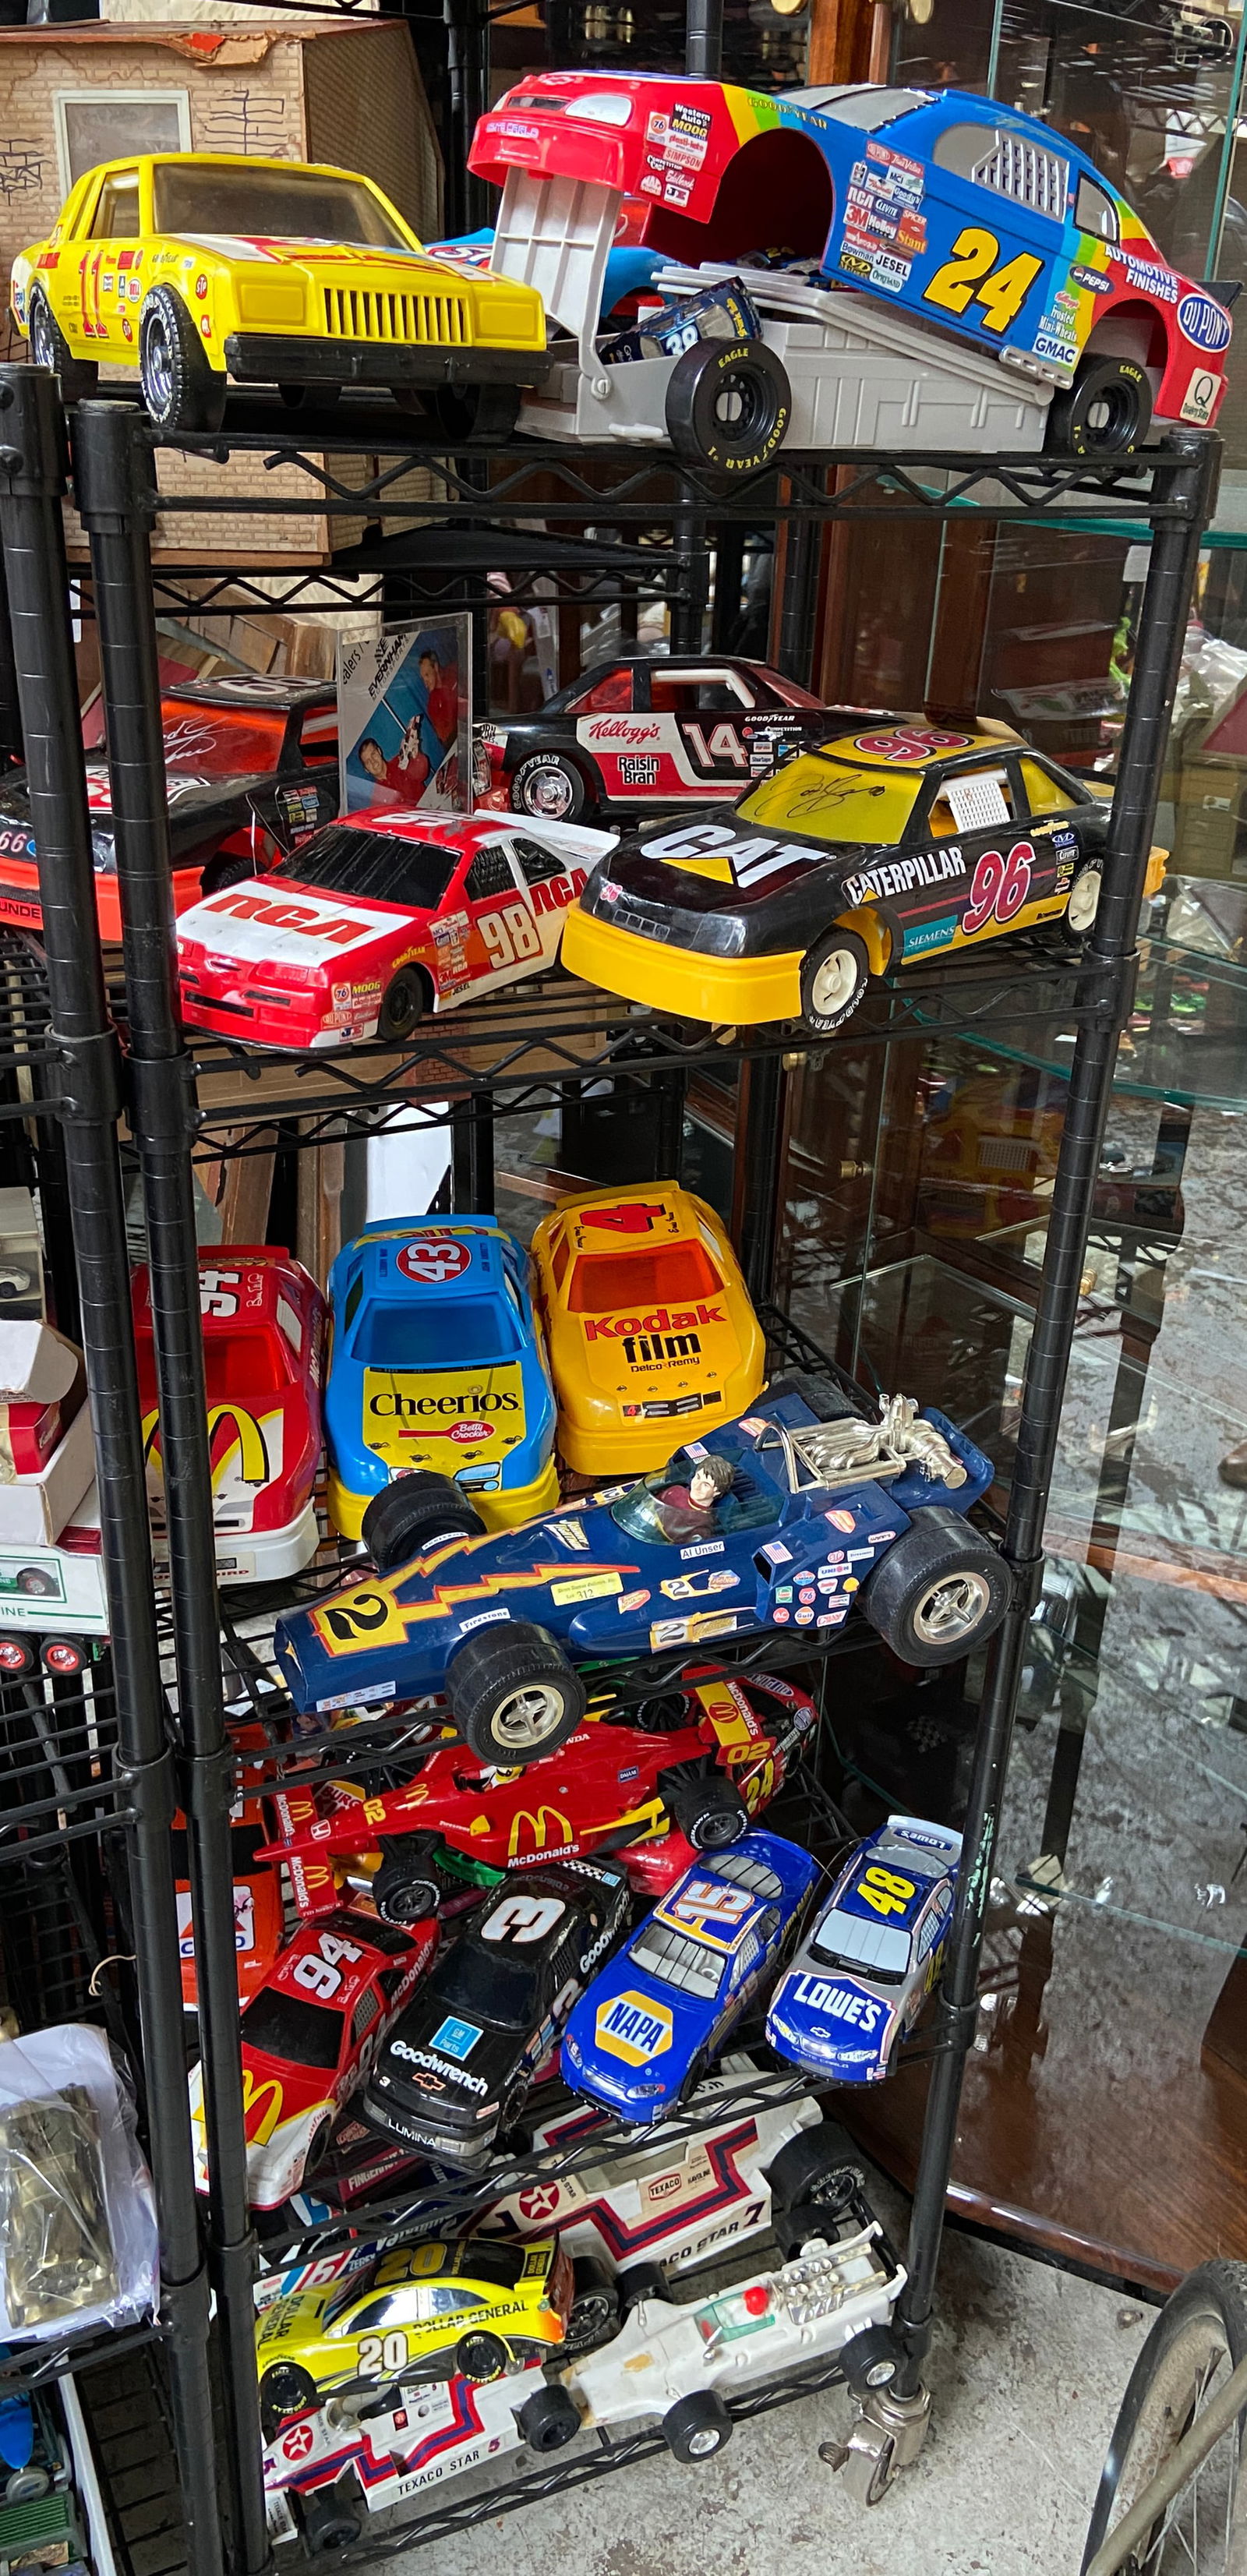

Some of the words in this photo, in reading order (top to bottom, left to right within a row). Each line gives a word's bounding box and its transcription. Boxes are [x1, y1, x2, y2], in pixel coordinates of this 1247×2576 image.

[654, 120, 664, 129] 76
[675, 104, 710, 122] Western
[680, 113, 701, 125] Auto
[747, 97, 828, 131] GOODYEAR
[672, 118, 707, 138] MOOG
[666, 150, 701, 168] SIMPSON
[890, 171, 903, 184] MCI
[847, 187, 873, 208] RCA
[846, 207, 870, 227] 3M
[868, 214, 896, 239] Holley
[903, 209, 927, 224] SPICER
[842, 242, 874, 262] Bowman
[898, 229, 927, 252] Stant
[876, 253, 908, 277] JESEL
[1104, 244, 1178, 288] AUTOMOTIVE
[78, 249, 110, 338] 11
[196, 275, 207, 294] STP
[922, 226, 1045, 335] 24
[1082, 272, 1111, 292] PEPSI
[1125, 271, 1178, 304] FINISHES
[1038, 315, 1078, 342] Mini-Wheats
[1051, 305, 1076, 326] Frosted
[718, 347, 749, 369] EAGLE
[1035, 340, 1076, 363] GMAC
[1118, 364, 1143, 383] EAGLE
[368, 634, 407, 698] EVERNHAM
[588, 718, 661, 744] Kellogg's
[744, 714, 795, 723] GOODYEAR
[682, 723, 749, 768] 14
[853, 726, 972, 762] 96
[617, 754, 660, 772] Raisin
[512, 754, 561, 811] GOODYEAR
[623, 769, 656, 786] Bran
[0, 830, 28, 853] 66
[640, 824, 832, 889] CAT
[845, 845, 967, 906] CATERPILLAR
[962, 840, 1037, 935] 96
[528, 868, 588, 917] RCA
[202, 893, 376, 946] RCA
[476, 903, 543, 970] 98
[908, 924, 956, 949] SIEMENS
[336, 988, 347, 998] 76
[351, 981, 381, 995] MOOG
[580, 1203, 667, 1235] 4
[406, 1242, 461, 1282] 43
[584, 1305, 727, 1341] Kodak
[622, 1332, 702, 1364] film
[369, 1390, 521, 1417] Cheerios
[627, 1405, 637, 1415] 4
[450, 1429, 490, 1441] Crocker
[458, 1423, 484, 1434] Betty
[682, 1549, 694, 1559] Al
[695, 1542, 723, 1557] Unser
[576, 1588, 594, 1600] 312
[667, 1580, 690, 1596] 2
[322, 1593, 389, 1641] 2
[462, 1610, 510, 1631] Firestone
[660, 1622, 686, 1642] 2
[726, 1681, 760, 1737] McDonald's
[566, 1733, 591, 1745] NDA
[726, 1741, 771, 1765] 02
[275, 1794, 295, 1836] McDonald's
[362, 1798, 387, 1826] 02
[507, 1843, 580, 1869] McDonald's
[290, 1856, 310, 1909] McDonald's
[857, 1866, 917, 1916] 48
[672, 1879, 756, 1926] 15
[481, 1895, 567, 1943] 3
[293, 1932, 363, 2000] 94
[793, 1974, 881, 2033] LOWE'S
[452, 2027, 465, 2039] GM
[604, 2002, 665, 2053] NAPA
[440, 2038, 460, 2053] Parts
[390, 2040, 489, 2097] Goodwrench
[379, 2076, 390, 2088] 3
[388, 2118, 437, 2147] LUMINA
[650, 2175, 681, 2197] TEXACO
[660, 2245, 692, 2268] ACO
[696, 2219, 740, 2255] STAR
[742, 2200, 767, 2229] 7
[373, 2242, 449, 2287] 20
[412, 2313, 470, 2337] DOLLAR
[468, 2300, 530, 2327] GENERAL
[356, 2330, 409, 2375] 20
[397, 2468, 443, 2496] TEXACO
[449, 2450, 480, 2472] STAR
[487, 2437, 501, 2453] 5
